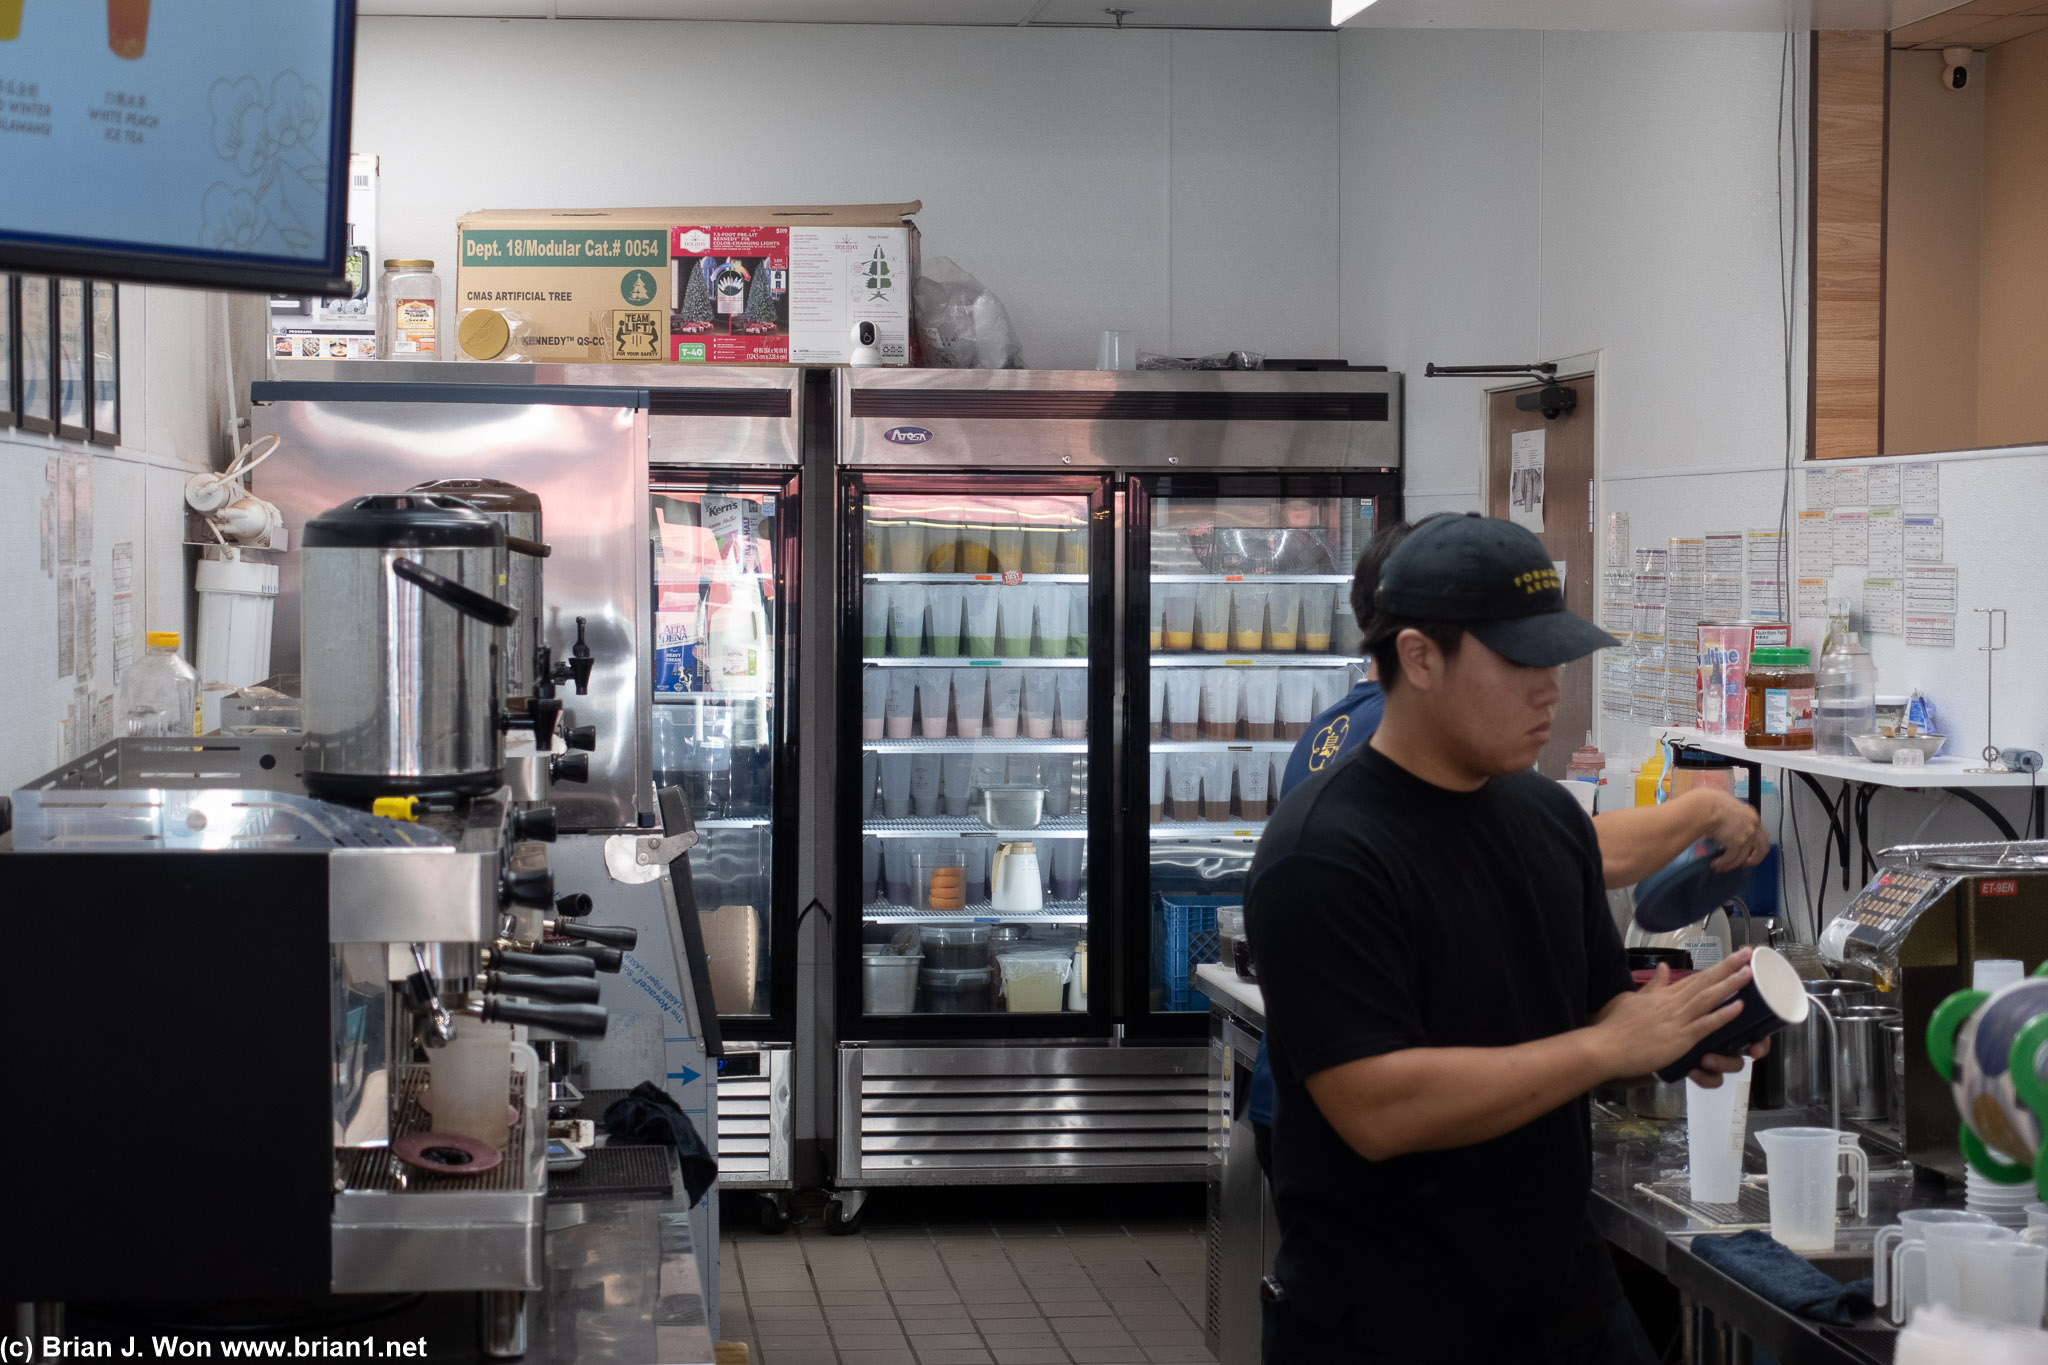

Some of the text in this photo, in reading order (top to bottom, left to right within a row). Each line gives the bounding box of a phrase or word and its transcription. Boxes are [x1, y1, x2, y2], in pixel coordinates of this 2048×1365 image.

[466, 239, 658, 260] Dept. 18/Modular Cat.# 0054
[467, 291, 573, 301] CMAS ARTIFICIAL TREE
[626, 314, 649, 323] TEAM
[625, 322, 650, 332] LIFT
[577, 336, 605, 346] QS-CC
[682, 348, 703, 356] T-40
[709, 500, 738, 517] Kern's
[743, 516, 751, 535] HALF
[664, 624, 687, 635] ALTA
[659, 632, 688, 643] DENA
[1982, 882, 2015, 894] ET-9EN
[646, 975, 664, 991] Fiber
[661, 988, 683, 1009] LASER
[670, 1009, 685, 1025] The
